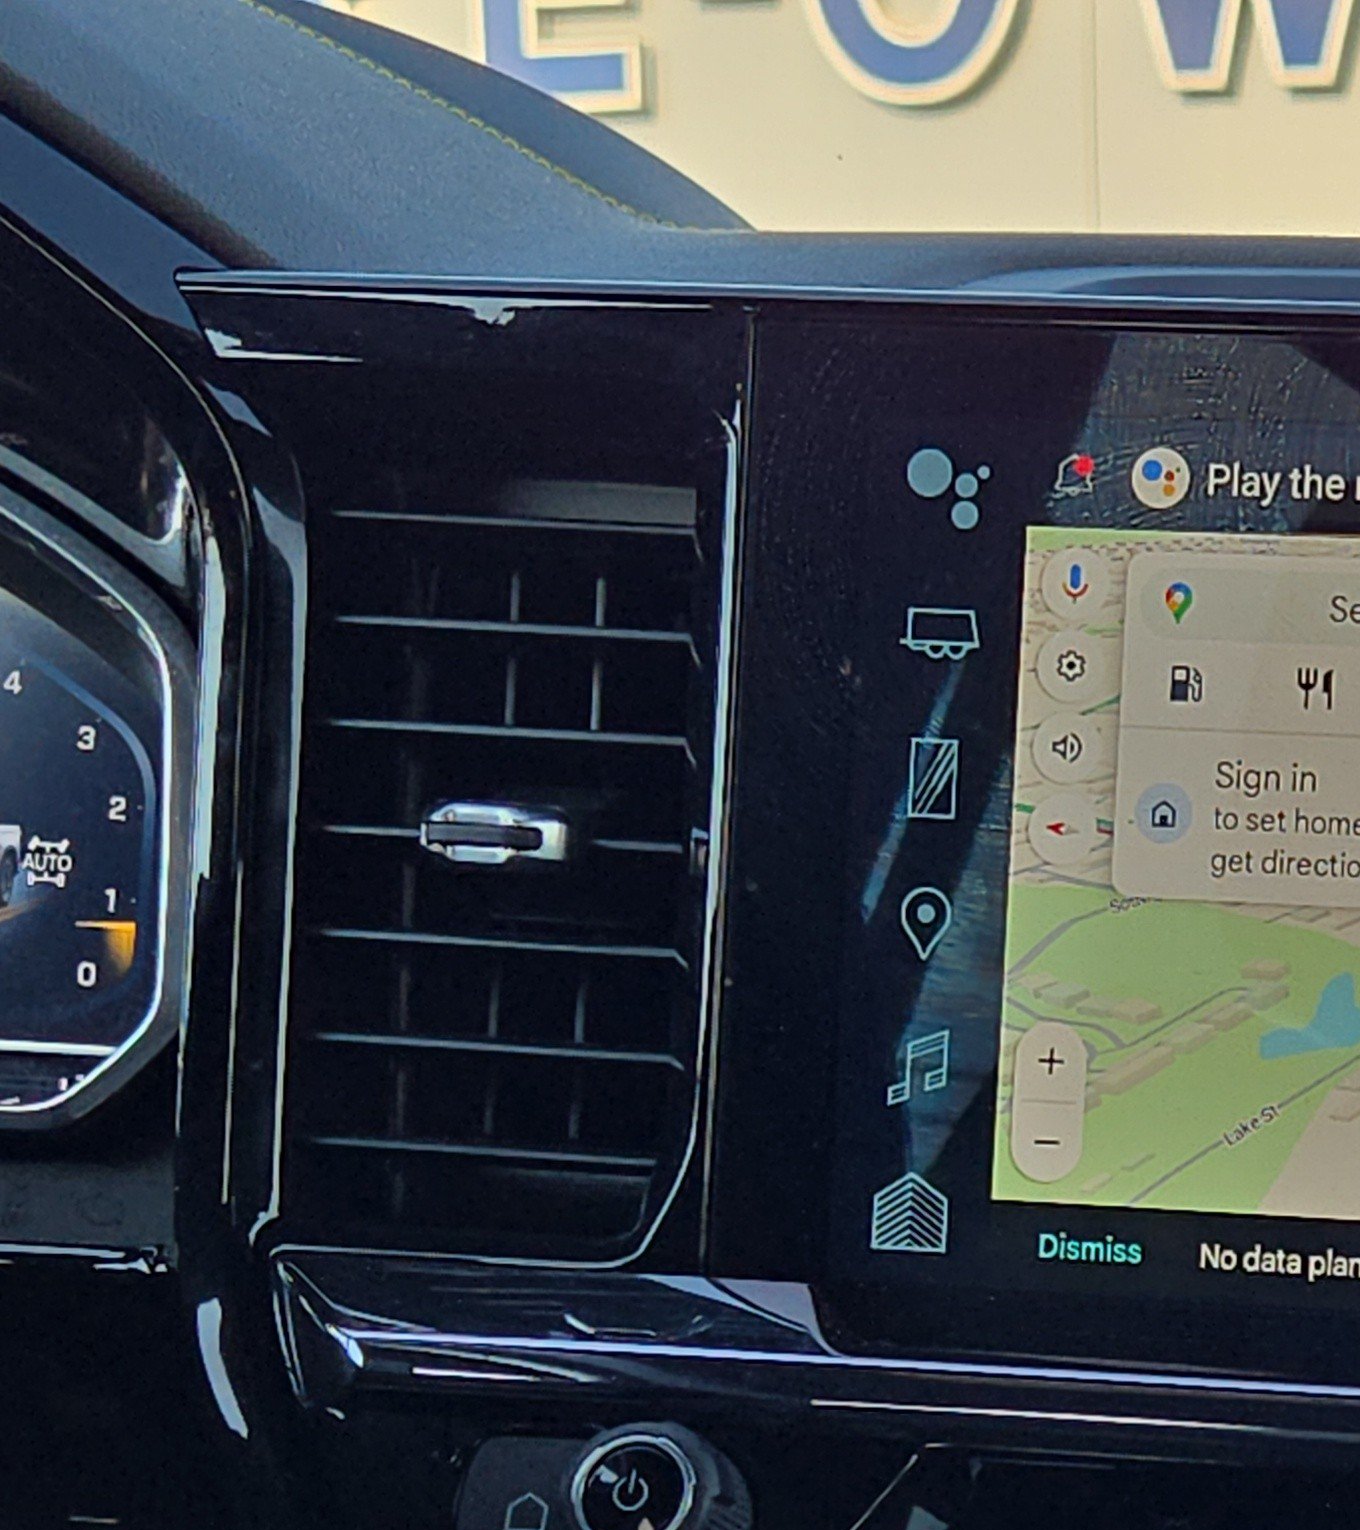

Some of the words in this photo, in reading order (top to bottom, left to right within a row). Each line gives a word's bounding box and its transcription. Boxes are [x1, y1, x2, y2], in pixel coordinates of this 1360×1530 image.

[1207, 461, 1281, 507] Play
[1289, 464, 1346, 500] the
[3, 671, 22, 695] 4
[77, 726, 96, 750] 3
[1215, 761, 1281, 797] Sign
[1291, 763, 1317, 792] in
[108, 797, 127, 822] 2
[1215, 808, 1238, 831] to
[1246, 810, 1286, 833] set
[22, 852, 72, 872] AUTO
[1211, 850, 1252, 878] get
[105, 889, 117, 913] 1
[76, 962, 97, 987] 0
[1223, 1117, 1259, 1146] Lake
[1261, 1105, 1280, 1123] St
[1038, 1231, 1142, 1265] Dismiss
[1200, 1243, 1237, 1271] No
[1243, 1244, 1301, 1275] data
